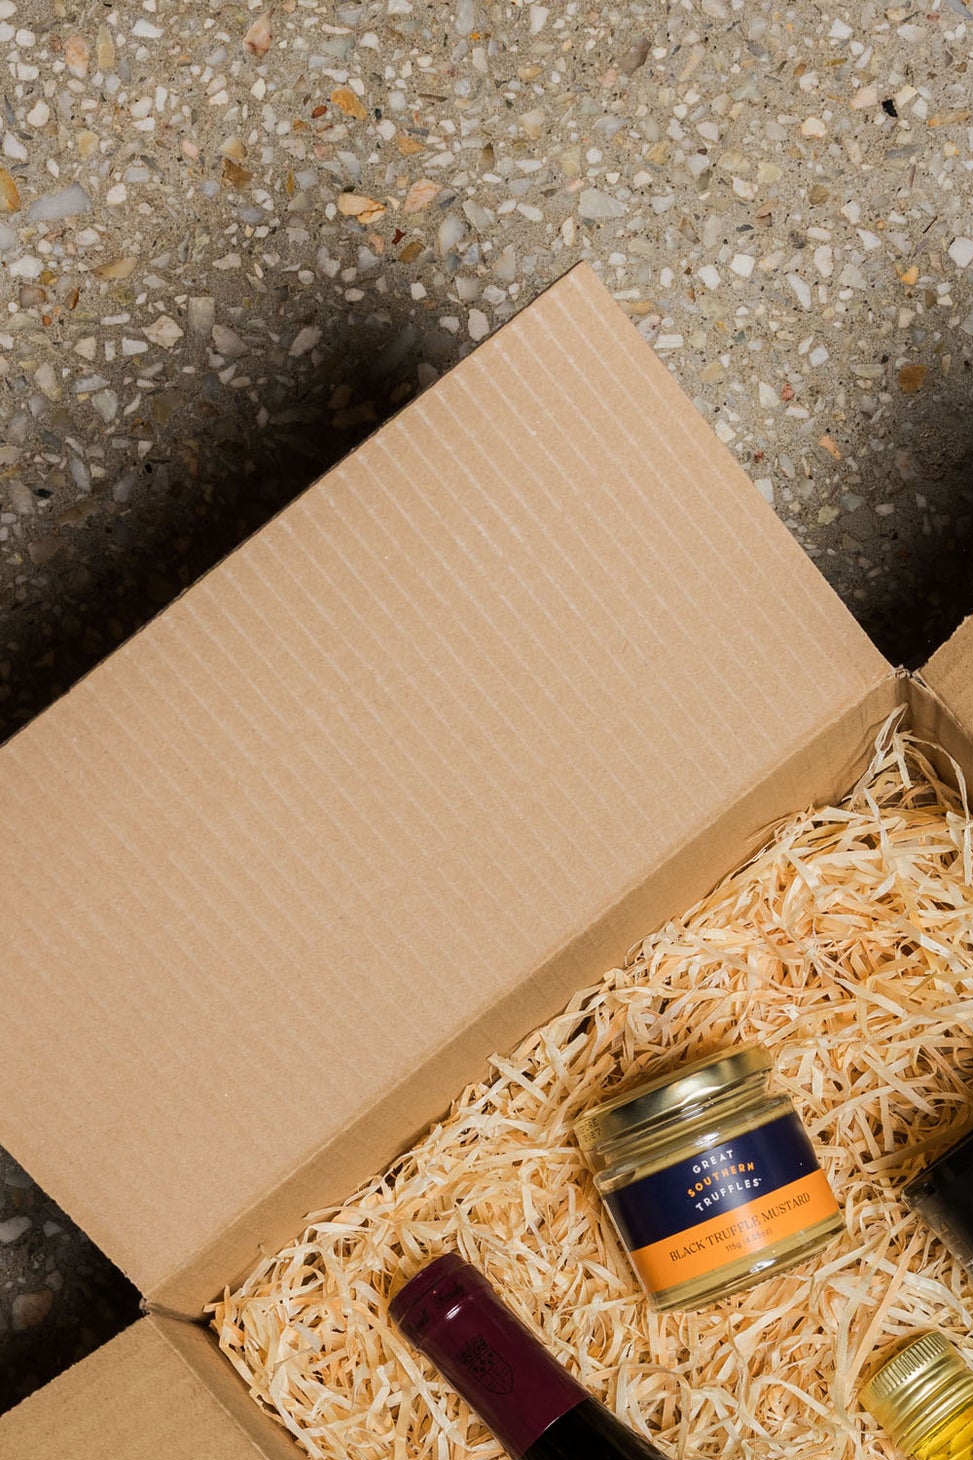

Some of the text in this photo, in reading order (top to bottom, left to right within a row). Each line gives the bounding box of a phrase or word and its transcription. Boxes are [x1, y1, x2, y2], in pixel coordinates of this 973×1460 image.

[687, 1161, 755, 1198] SOUTHERN
[692, 1150, 734, 1174] GREAT
[669, 1192, 811, 1262] BLACK TRUFFLE MUSTARD
